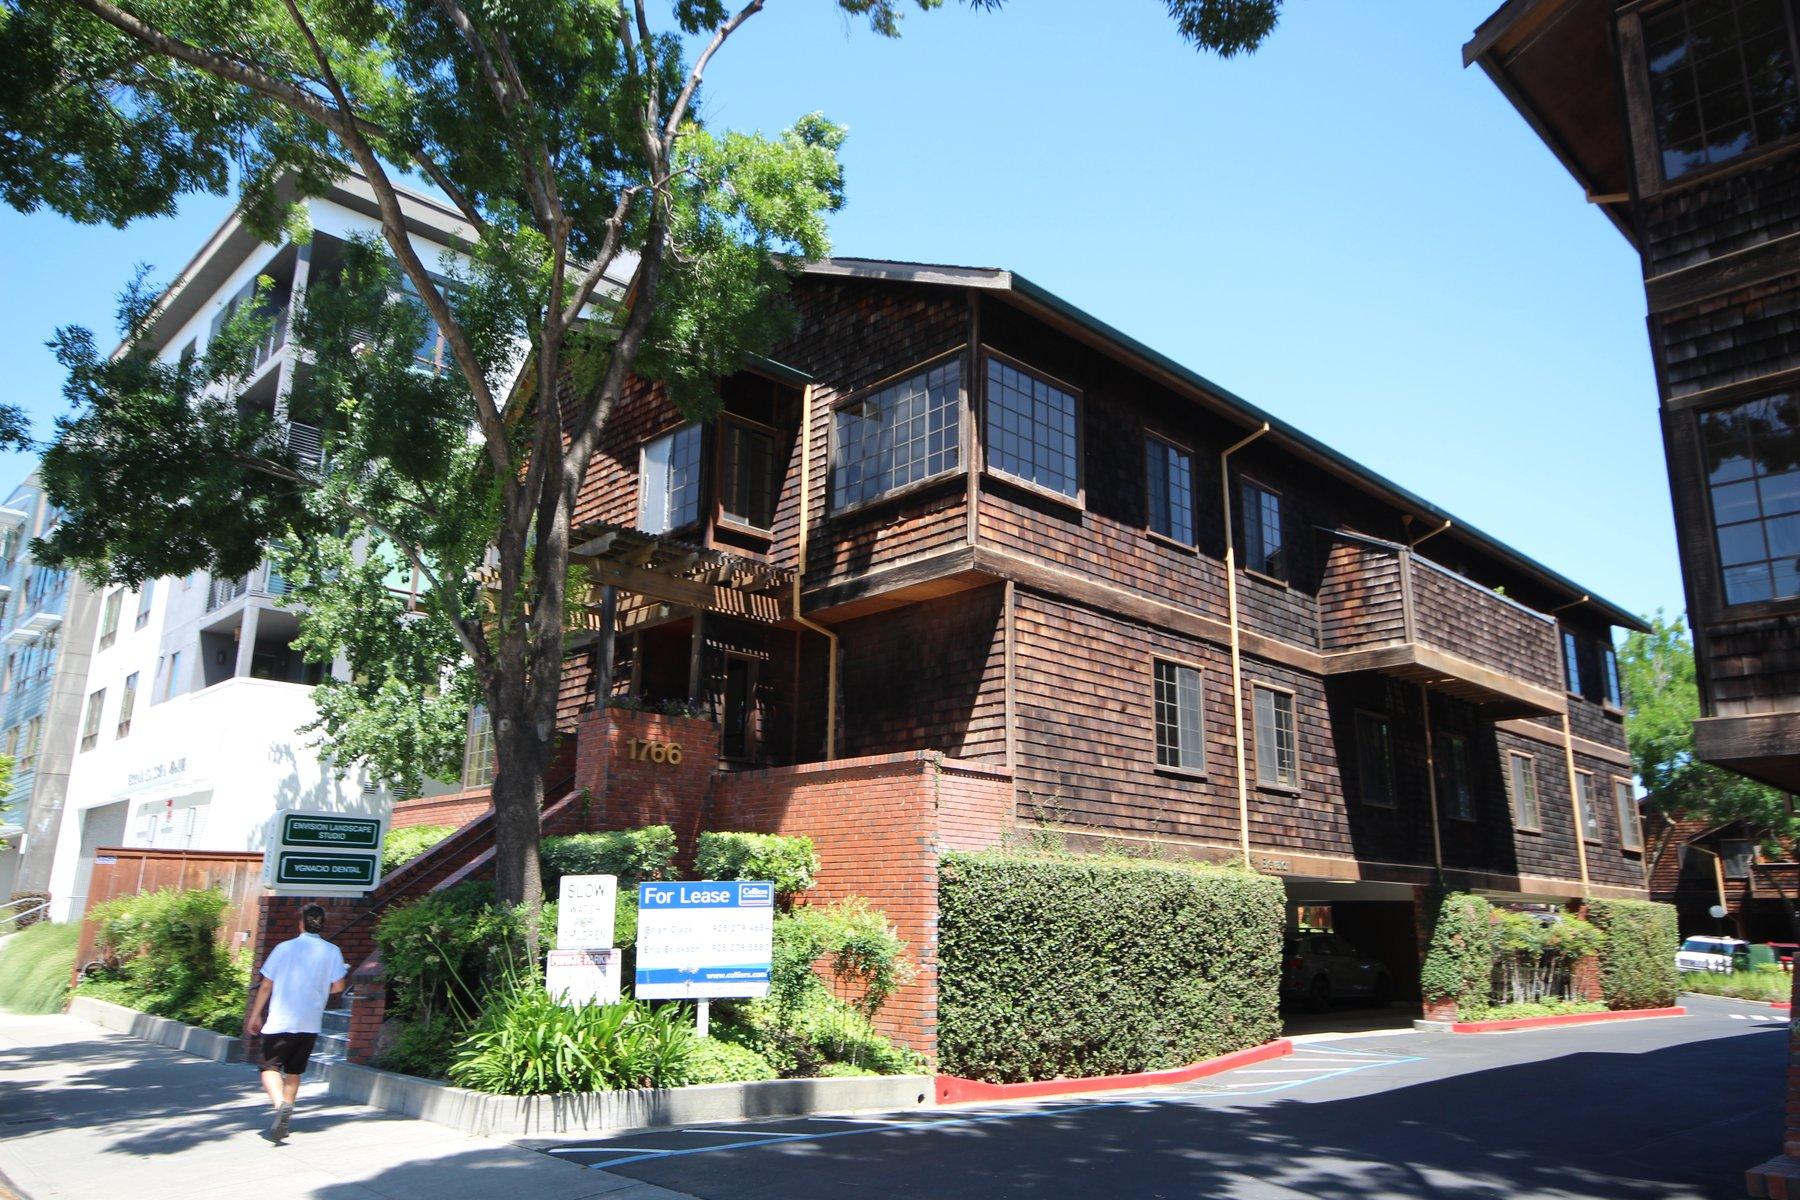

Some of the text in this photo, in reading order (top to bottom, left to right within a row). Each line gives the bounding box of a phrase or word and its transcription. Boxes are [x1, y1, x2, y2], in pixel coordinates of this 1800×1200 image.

[625, 737, 683, 765] 1766
[293, 822, 372, 833] ENVISION LANDSCAPE
[318, 832, 346, 840] STUDIO
[294, 864, 361, 874] YGNACIO DENTAL
[567, 882, 606, 899] SLOW
[645, 886, 730, 905] For Lease
